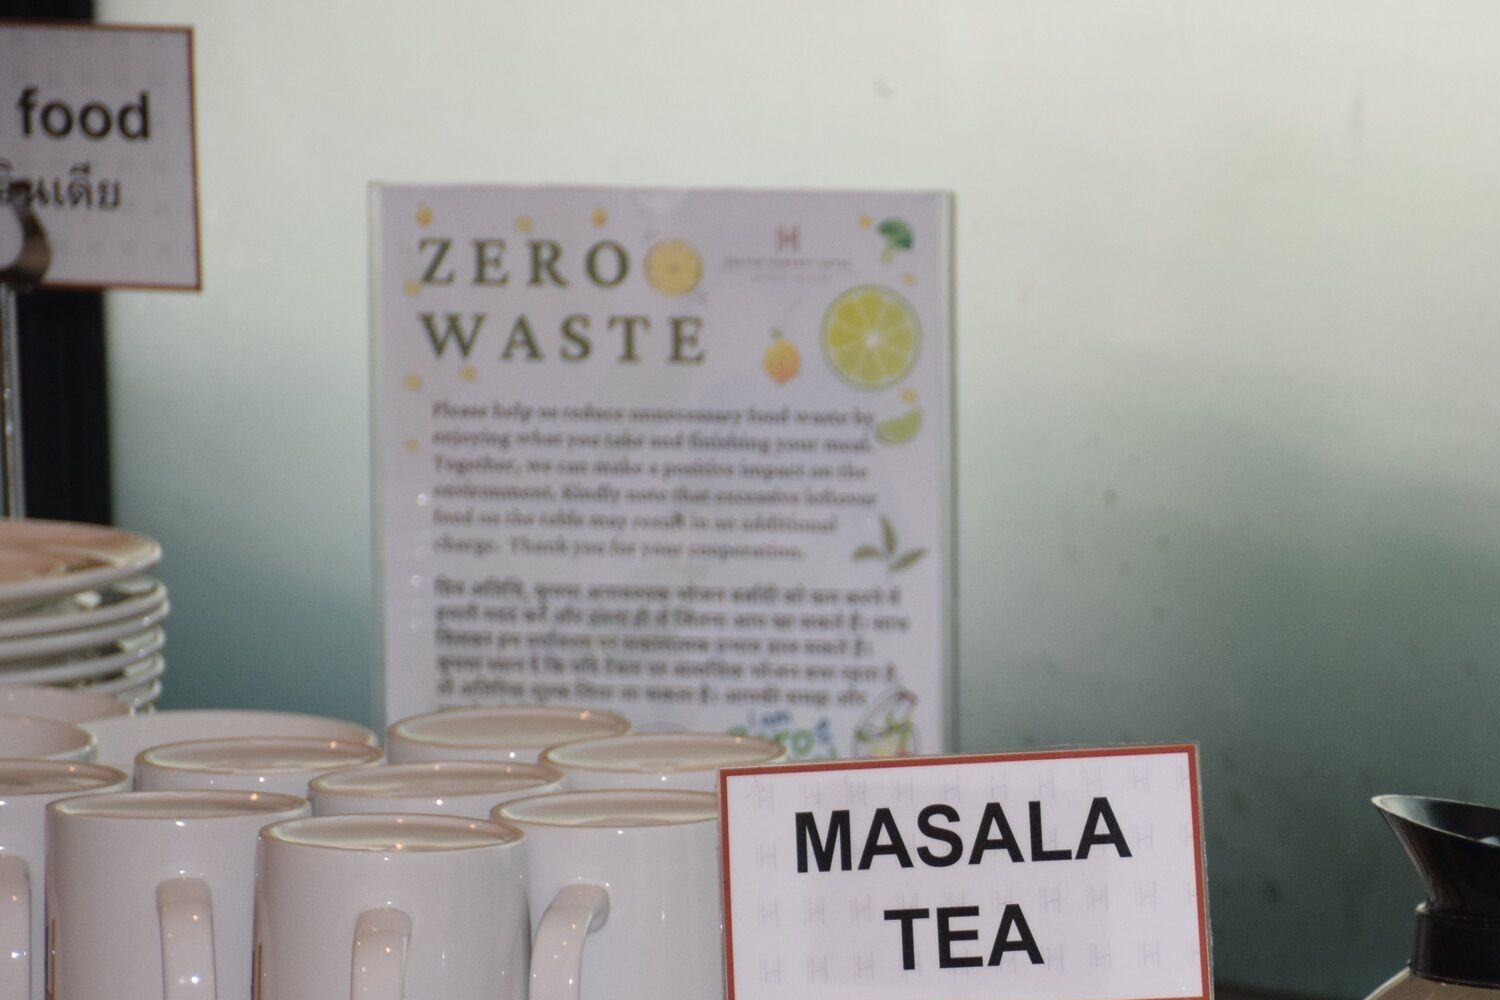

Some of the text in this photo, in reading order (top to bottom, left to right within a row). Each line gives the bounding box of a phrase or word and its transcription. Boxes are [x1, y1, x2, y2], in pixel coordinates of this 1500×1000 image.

[18, 86, 150, 140] food
[417, 238, 631, 287] ZERO
[417, 311, 707, 364] WASTE
[795, 797, 1133, 874] MASALA
[883, 903, 1046, 971] TEA
